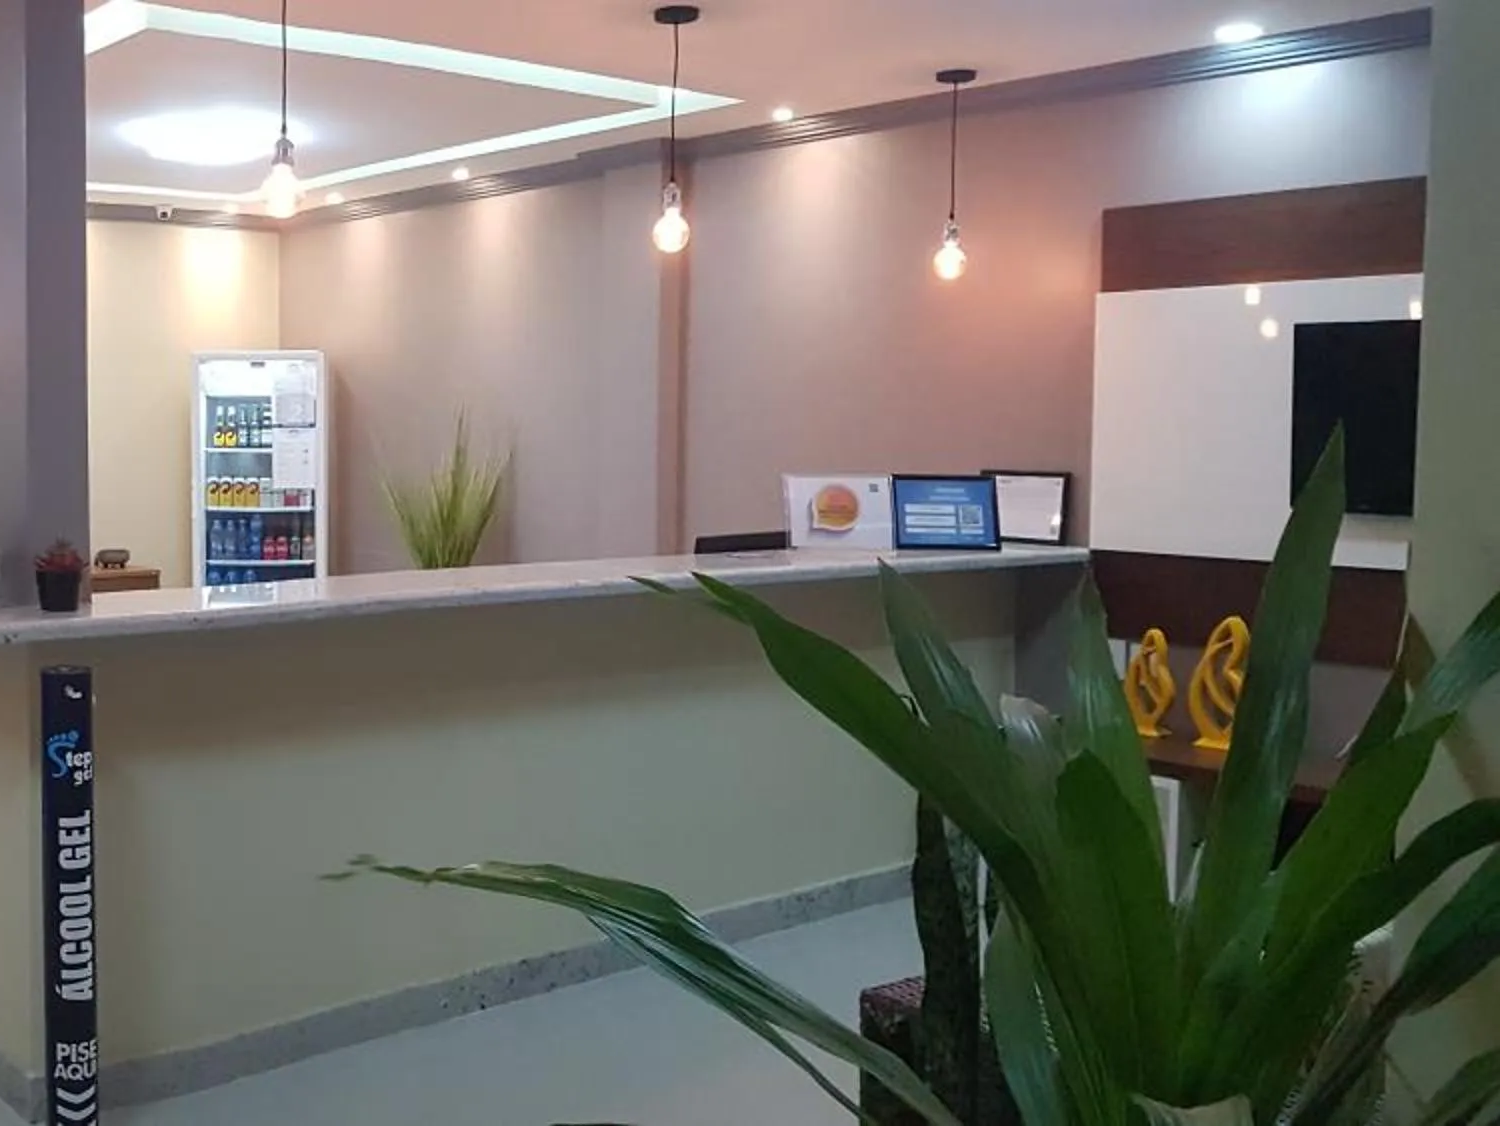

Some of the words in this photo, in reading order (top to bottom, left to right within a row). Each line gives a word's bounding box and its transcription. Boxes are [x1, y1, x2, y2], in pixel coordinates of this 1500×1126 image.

[58, 809, 92, 870] GEL
[55, 875, 93, 1001] ÁLCOOL
[54, 1059, 97, 1081] AQU
[56, 1040, 98, 1062] PISE
